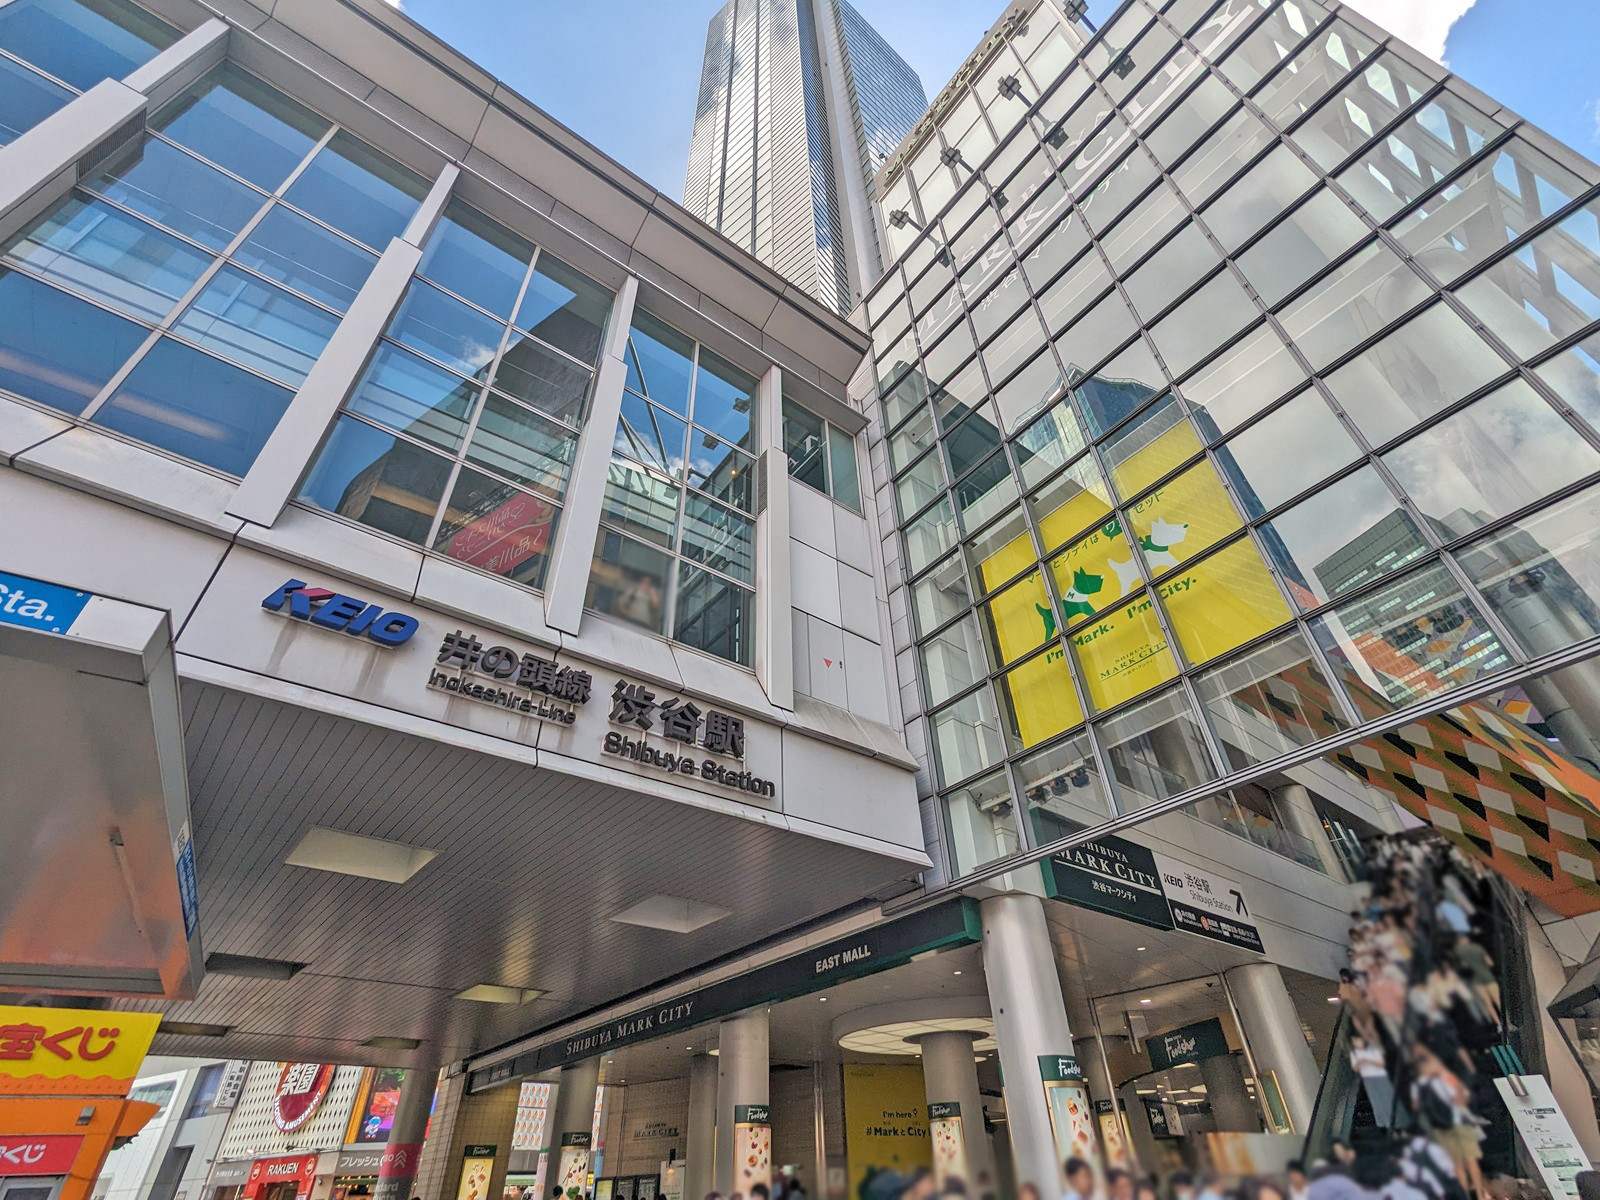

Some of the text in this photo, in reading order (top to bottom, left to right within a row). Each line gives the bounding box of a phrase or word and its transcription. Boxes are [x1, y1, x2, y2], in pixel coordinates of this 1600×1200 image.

[261, 578, 420, 647] KEIO
[1127, 577, 1197, 619] I'm City.
[1074, 624, 1115, 647] Mark.
[1100, 657, 1136, 678] MARK
[428, 667, 577, 726] Inokashira Line
[437, 629, 745, 759] 井の頭線 渋谷駅
[603, 731, 776, 798] Shibuya Station
[1055, 847, 1157, 889] MARK CITY
[1163, 873, 1184, 888] KEIO
[1091, 879, 1137, 903] 渋谷マークシティ
[1183, 872, 1213, 895] 渋谷駅
[1189, 889, 1234, 912] Shibuya Station
[815, 944, 871, 974] EAST MALL
[0, 1022, 121, 1061] 宝くじ
[566, 1001, 694, 1056] SHIBUYA MARK CITY
[284, 1091, 322, 1130] AMUSEMENT
[907, 1126, 926, 1138] City
[267, 1163, 299, 1176] RAKUEN
[340, 1155, 385, 1167] フレッシュ
